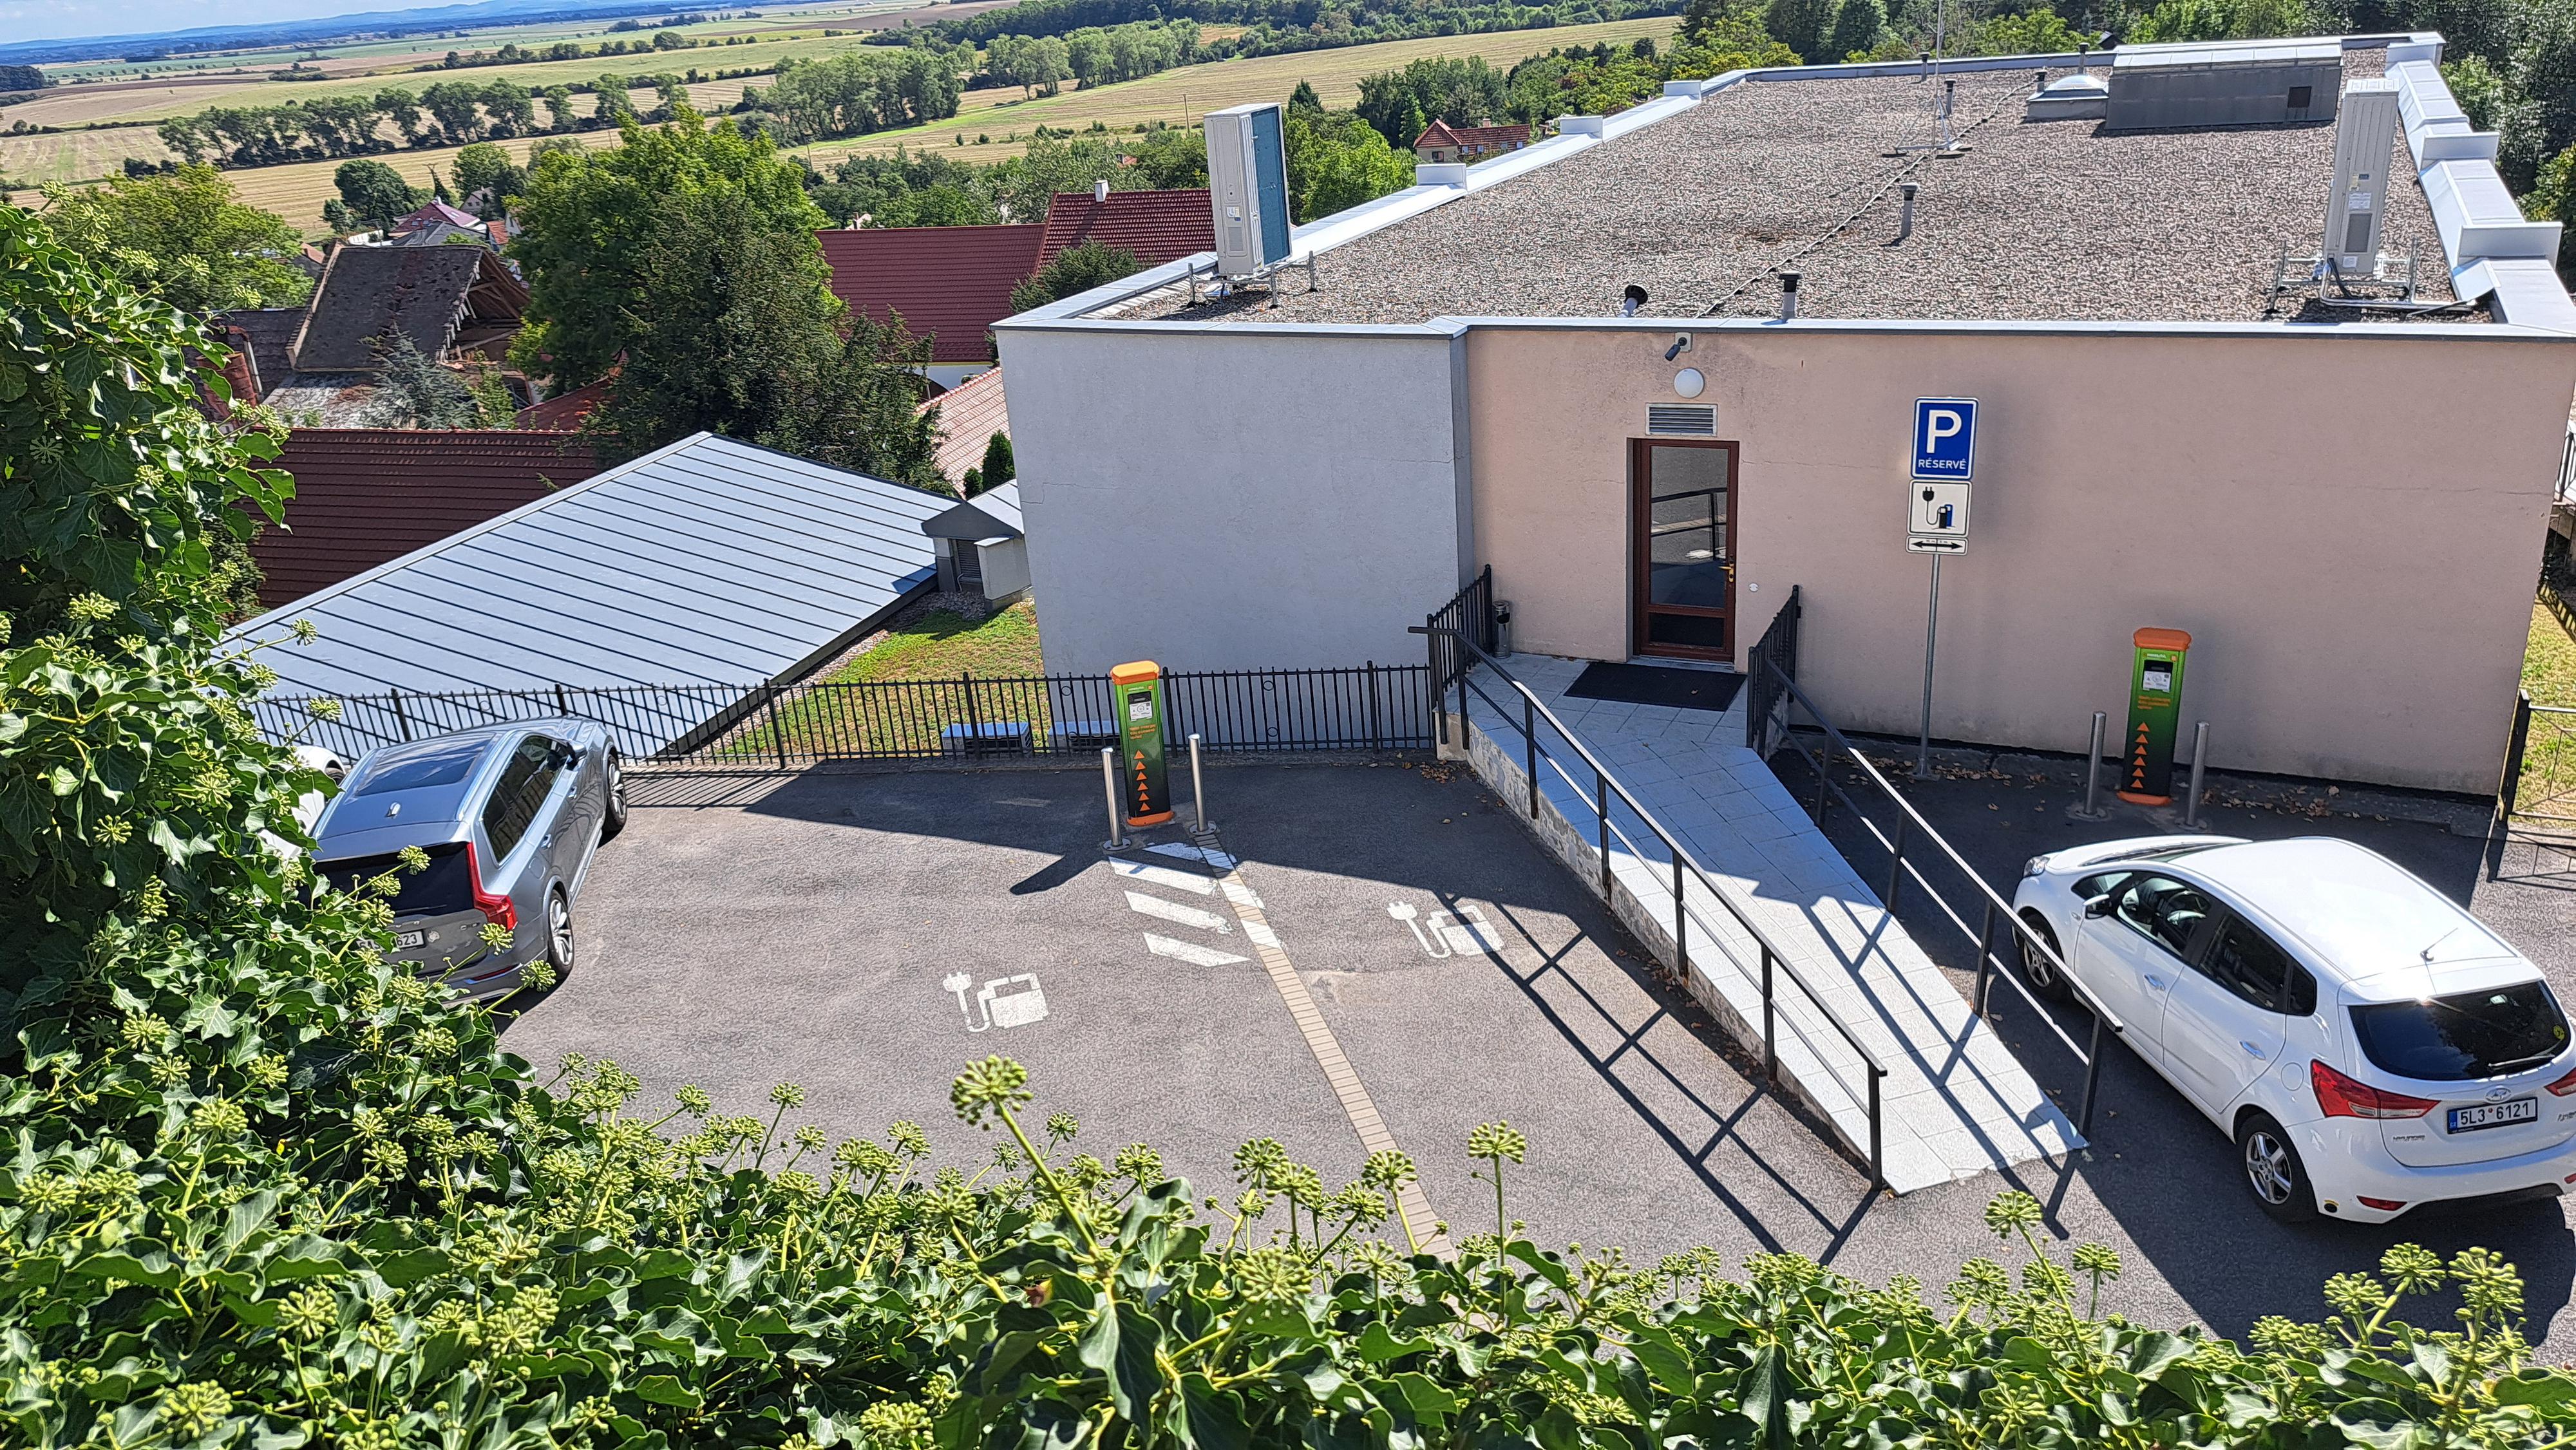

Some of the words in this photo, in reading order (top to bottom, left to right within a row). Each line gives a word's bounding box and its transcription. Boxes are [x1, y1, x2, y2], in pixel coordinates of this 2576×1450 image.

[1926, 410, 1962, 453] P
[1918, 457, 1967, 469] RÉSERVÉ
[2460, 1109, 2485, 1125] 5L3
[2496, 1102, 2528, 1120] 6121
